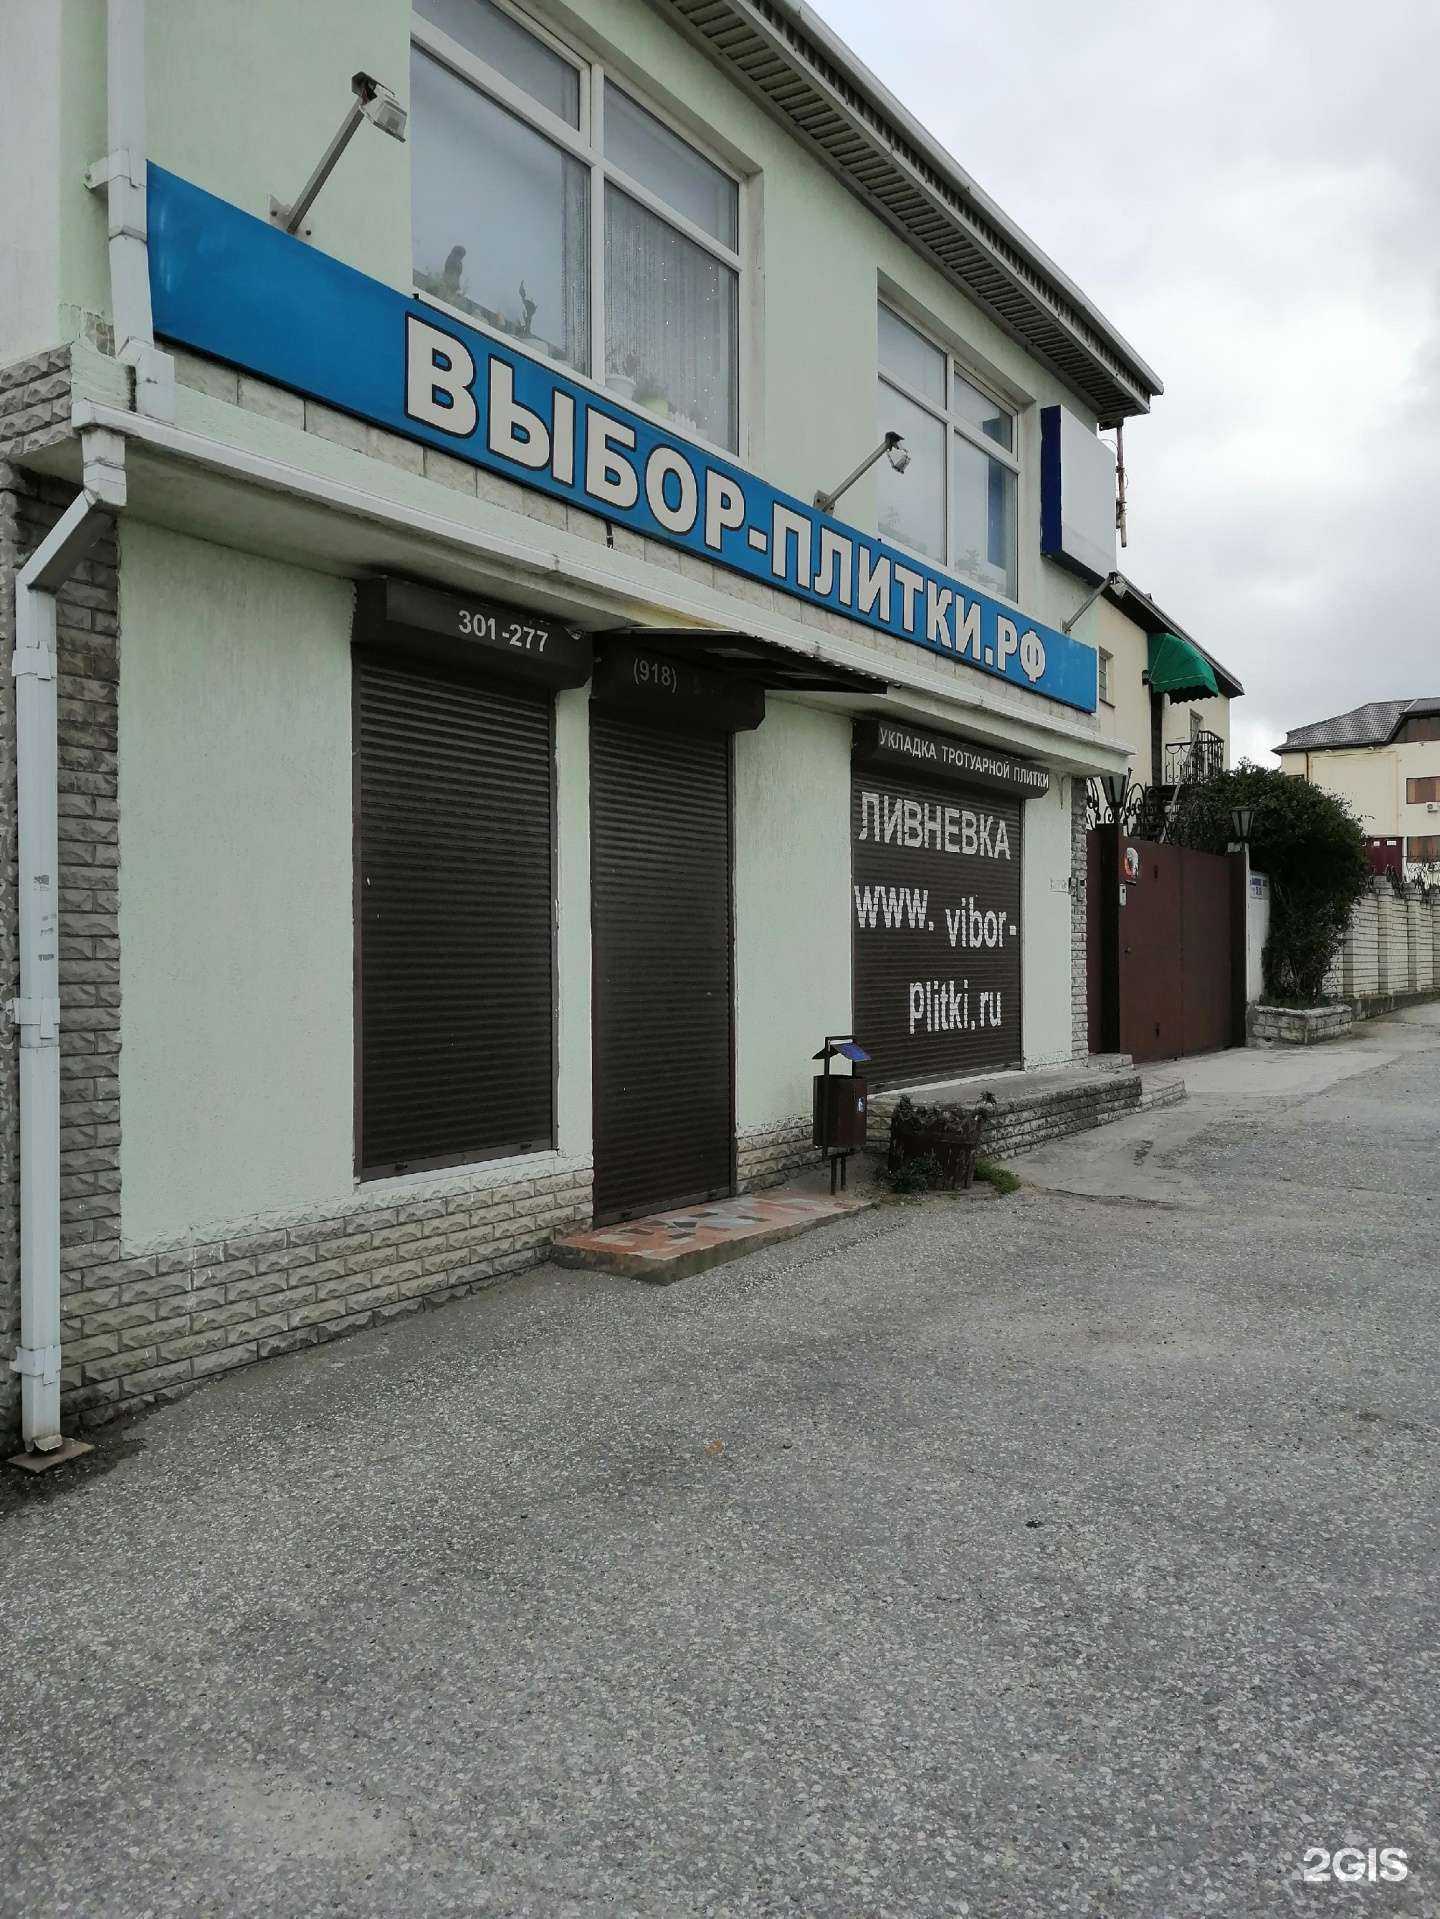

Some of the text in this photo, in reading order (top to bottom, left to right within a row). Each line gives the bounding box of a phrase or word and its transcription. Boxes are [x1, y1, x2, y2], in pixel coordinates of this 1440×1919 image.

[405, 310, 1047, 684] ВЫБОР-ПЛИТКИ.РФ
[458, 609, 549, 652] 301-277
[632, 656, 678, 694] (918)
[878, 726, 1050, 789] УКЛАДКА ТРОТУАРНОЙ ПЛИТКИ
[858, 791, 1011, 861] ЛИВНЕВКА
[853, 885, 1017, 949] www. vibor-
